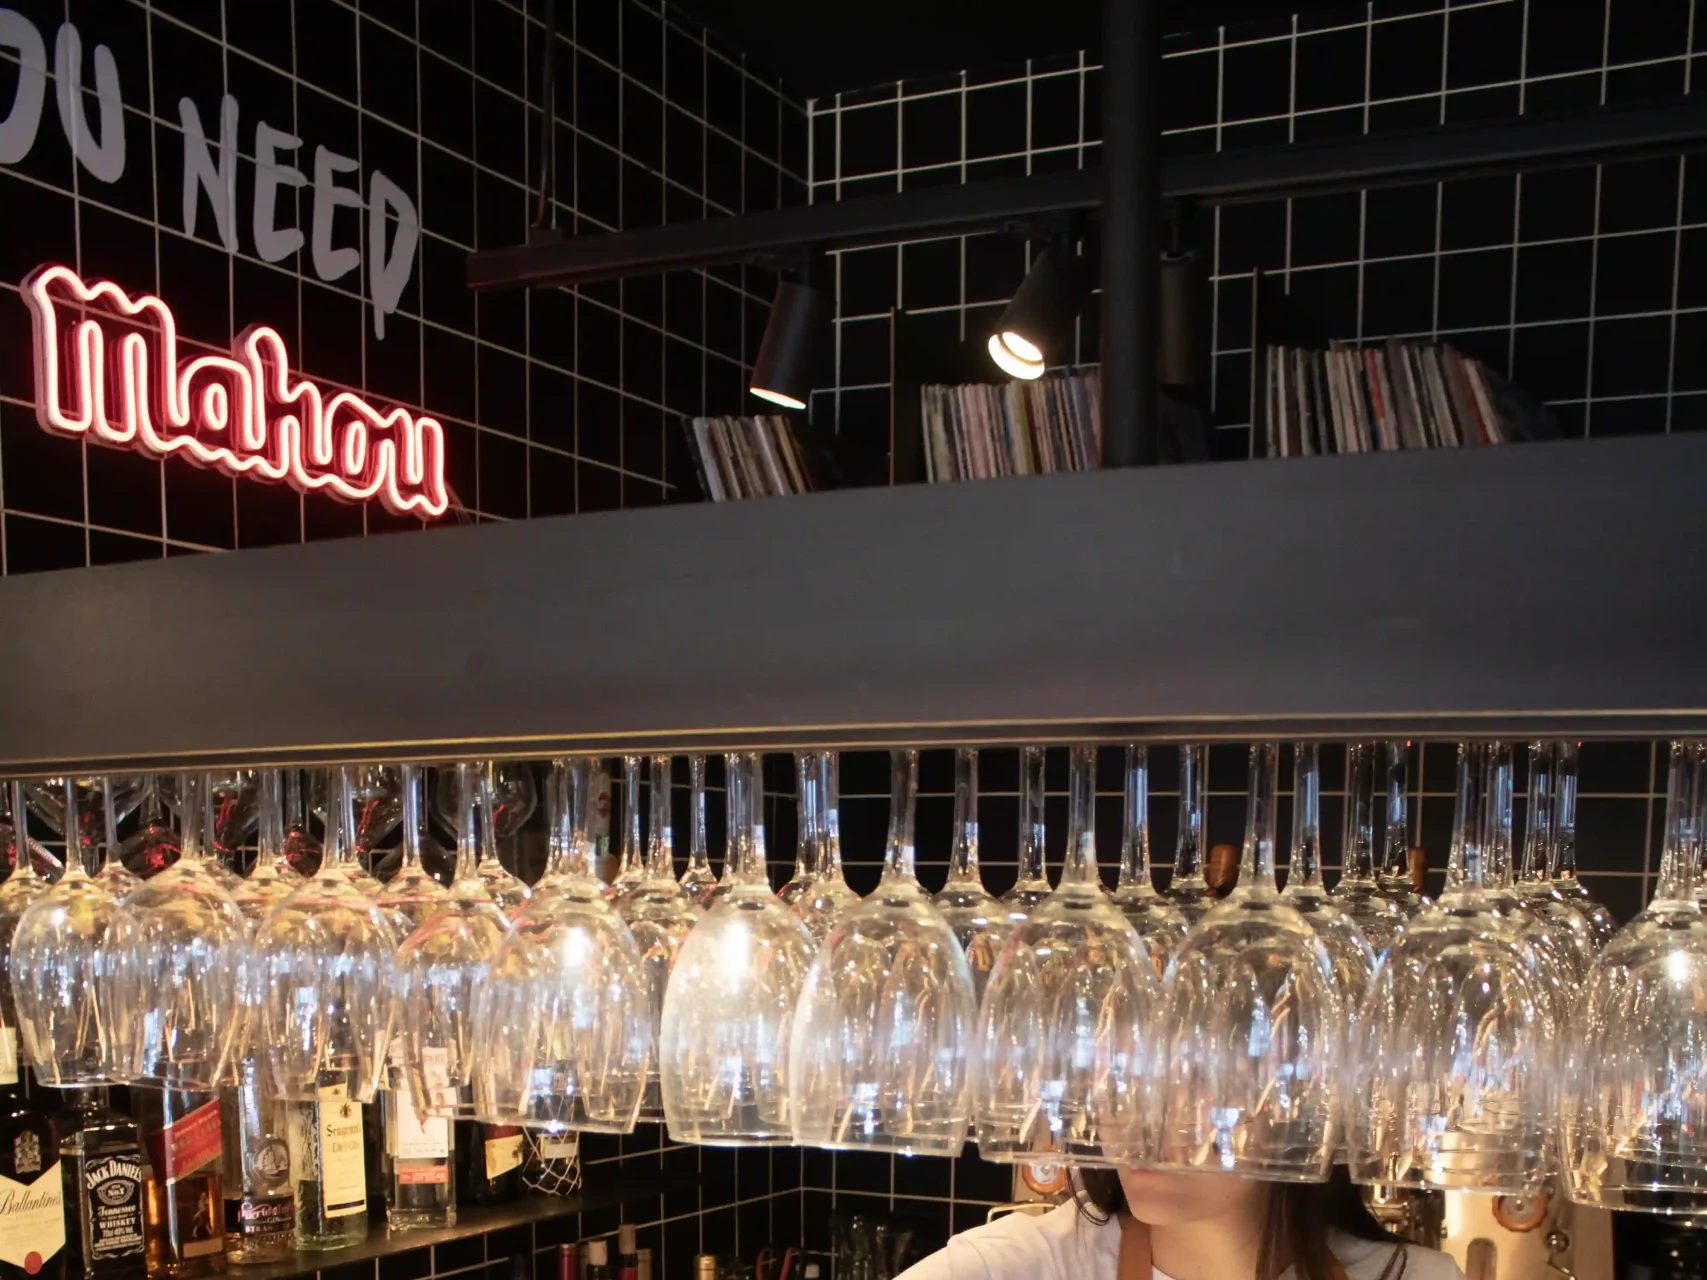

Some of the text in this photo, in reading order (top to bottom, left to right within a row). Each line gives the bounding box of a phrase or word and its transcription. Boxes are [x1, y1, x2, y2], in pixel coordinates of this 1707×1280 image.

[179, 94, 419, 340] NEED
[86, 1164, 110, 1190] JACK
[100, 1217, 136, 1229] WHISKEY
